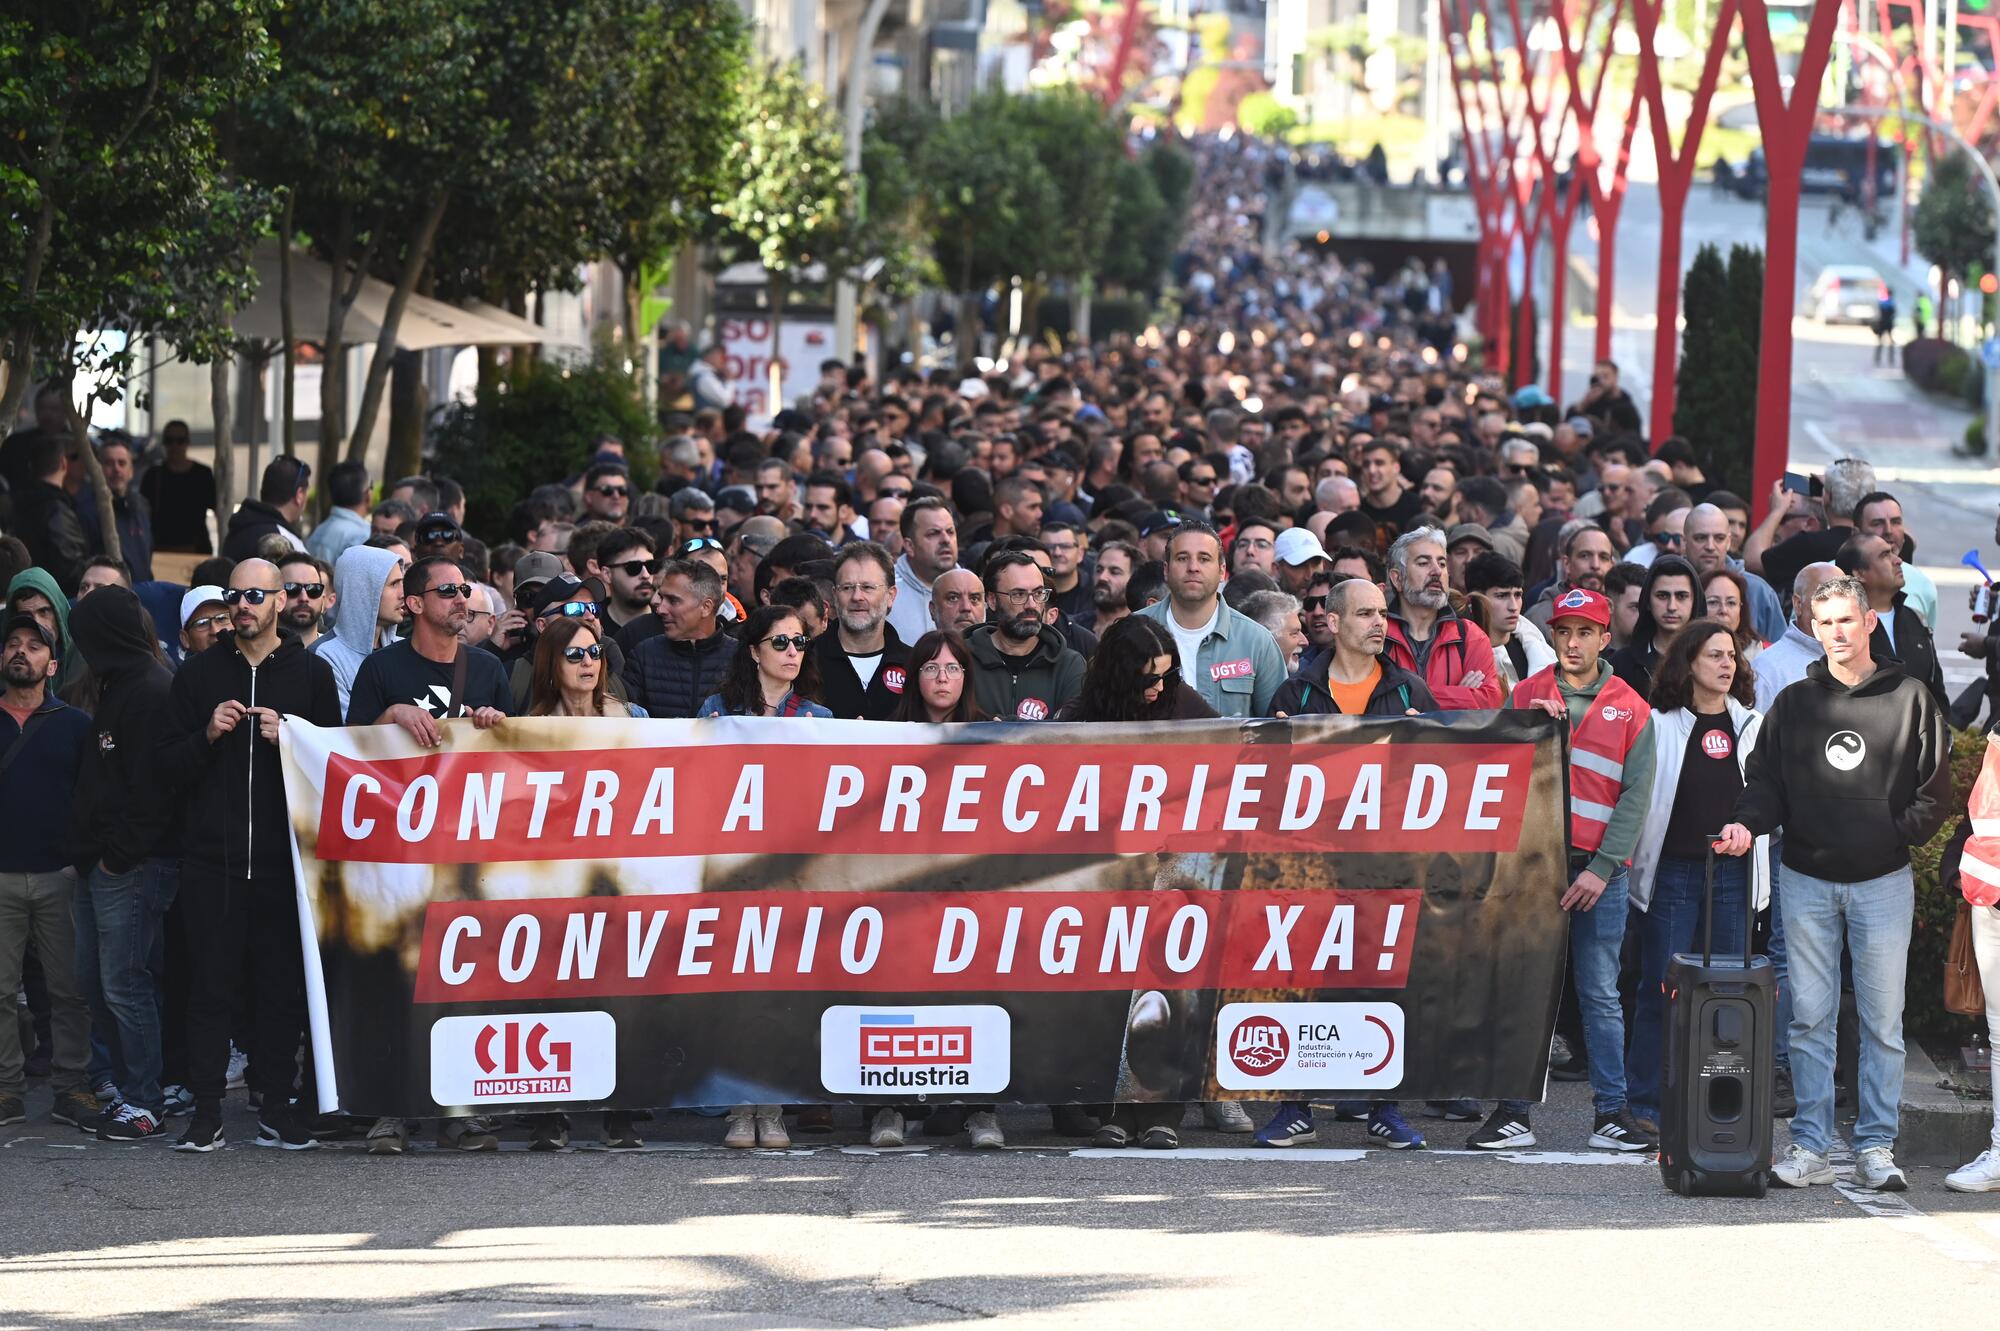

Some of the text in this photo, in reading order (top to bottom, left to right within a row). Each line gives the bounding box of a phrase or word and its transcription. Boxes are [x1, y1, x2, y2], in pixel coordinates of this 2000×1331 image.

[886, 670, 906, 685] CIG
[1210, 663, 1236, 679] UGT
[1023, 701, 1044, 721] CIG
[1705, 735, 1728, 749] CIG
[341, 763, 1510, 841] CONTRA A PRECARIEDADE
[439, 905, 1405, 986] CONVENIO DIGNO XA!
[1236, 1026, 1283, 1050] UGT
[1298, 1025, 1340, 1041] FICA
[475, 1022, 572, 1074] CIG
[867, 1034, 965, 1057] CCOO
[1298, 1050, 1373, 1060] Construcción y Agro
[1298, 1060, 1327, 1068] Galicia
[860, 1066, 970, 1086] industria
[476, 1078, 569, 1095] INDUSTRIA
